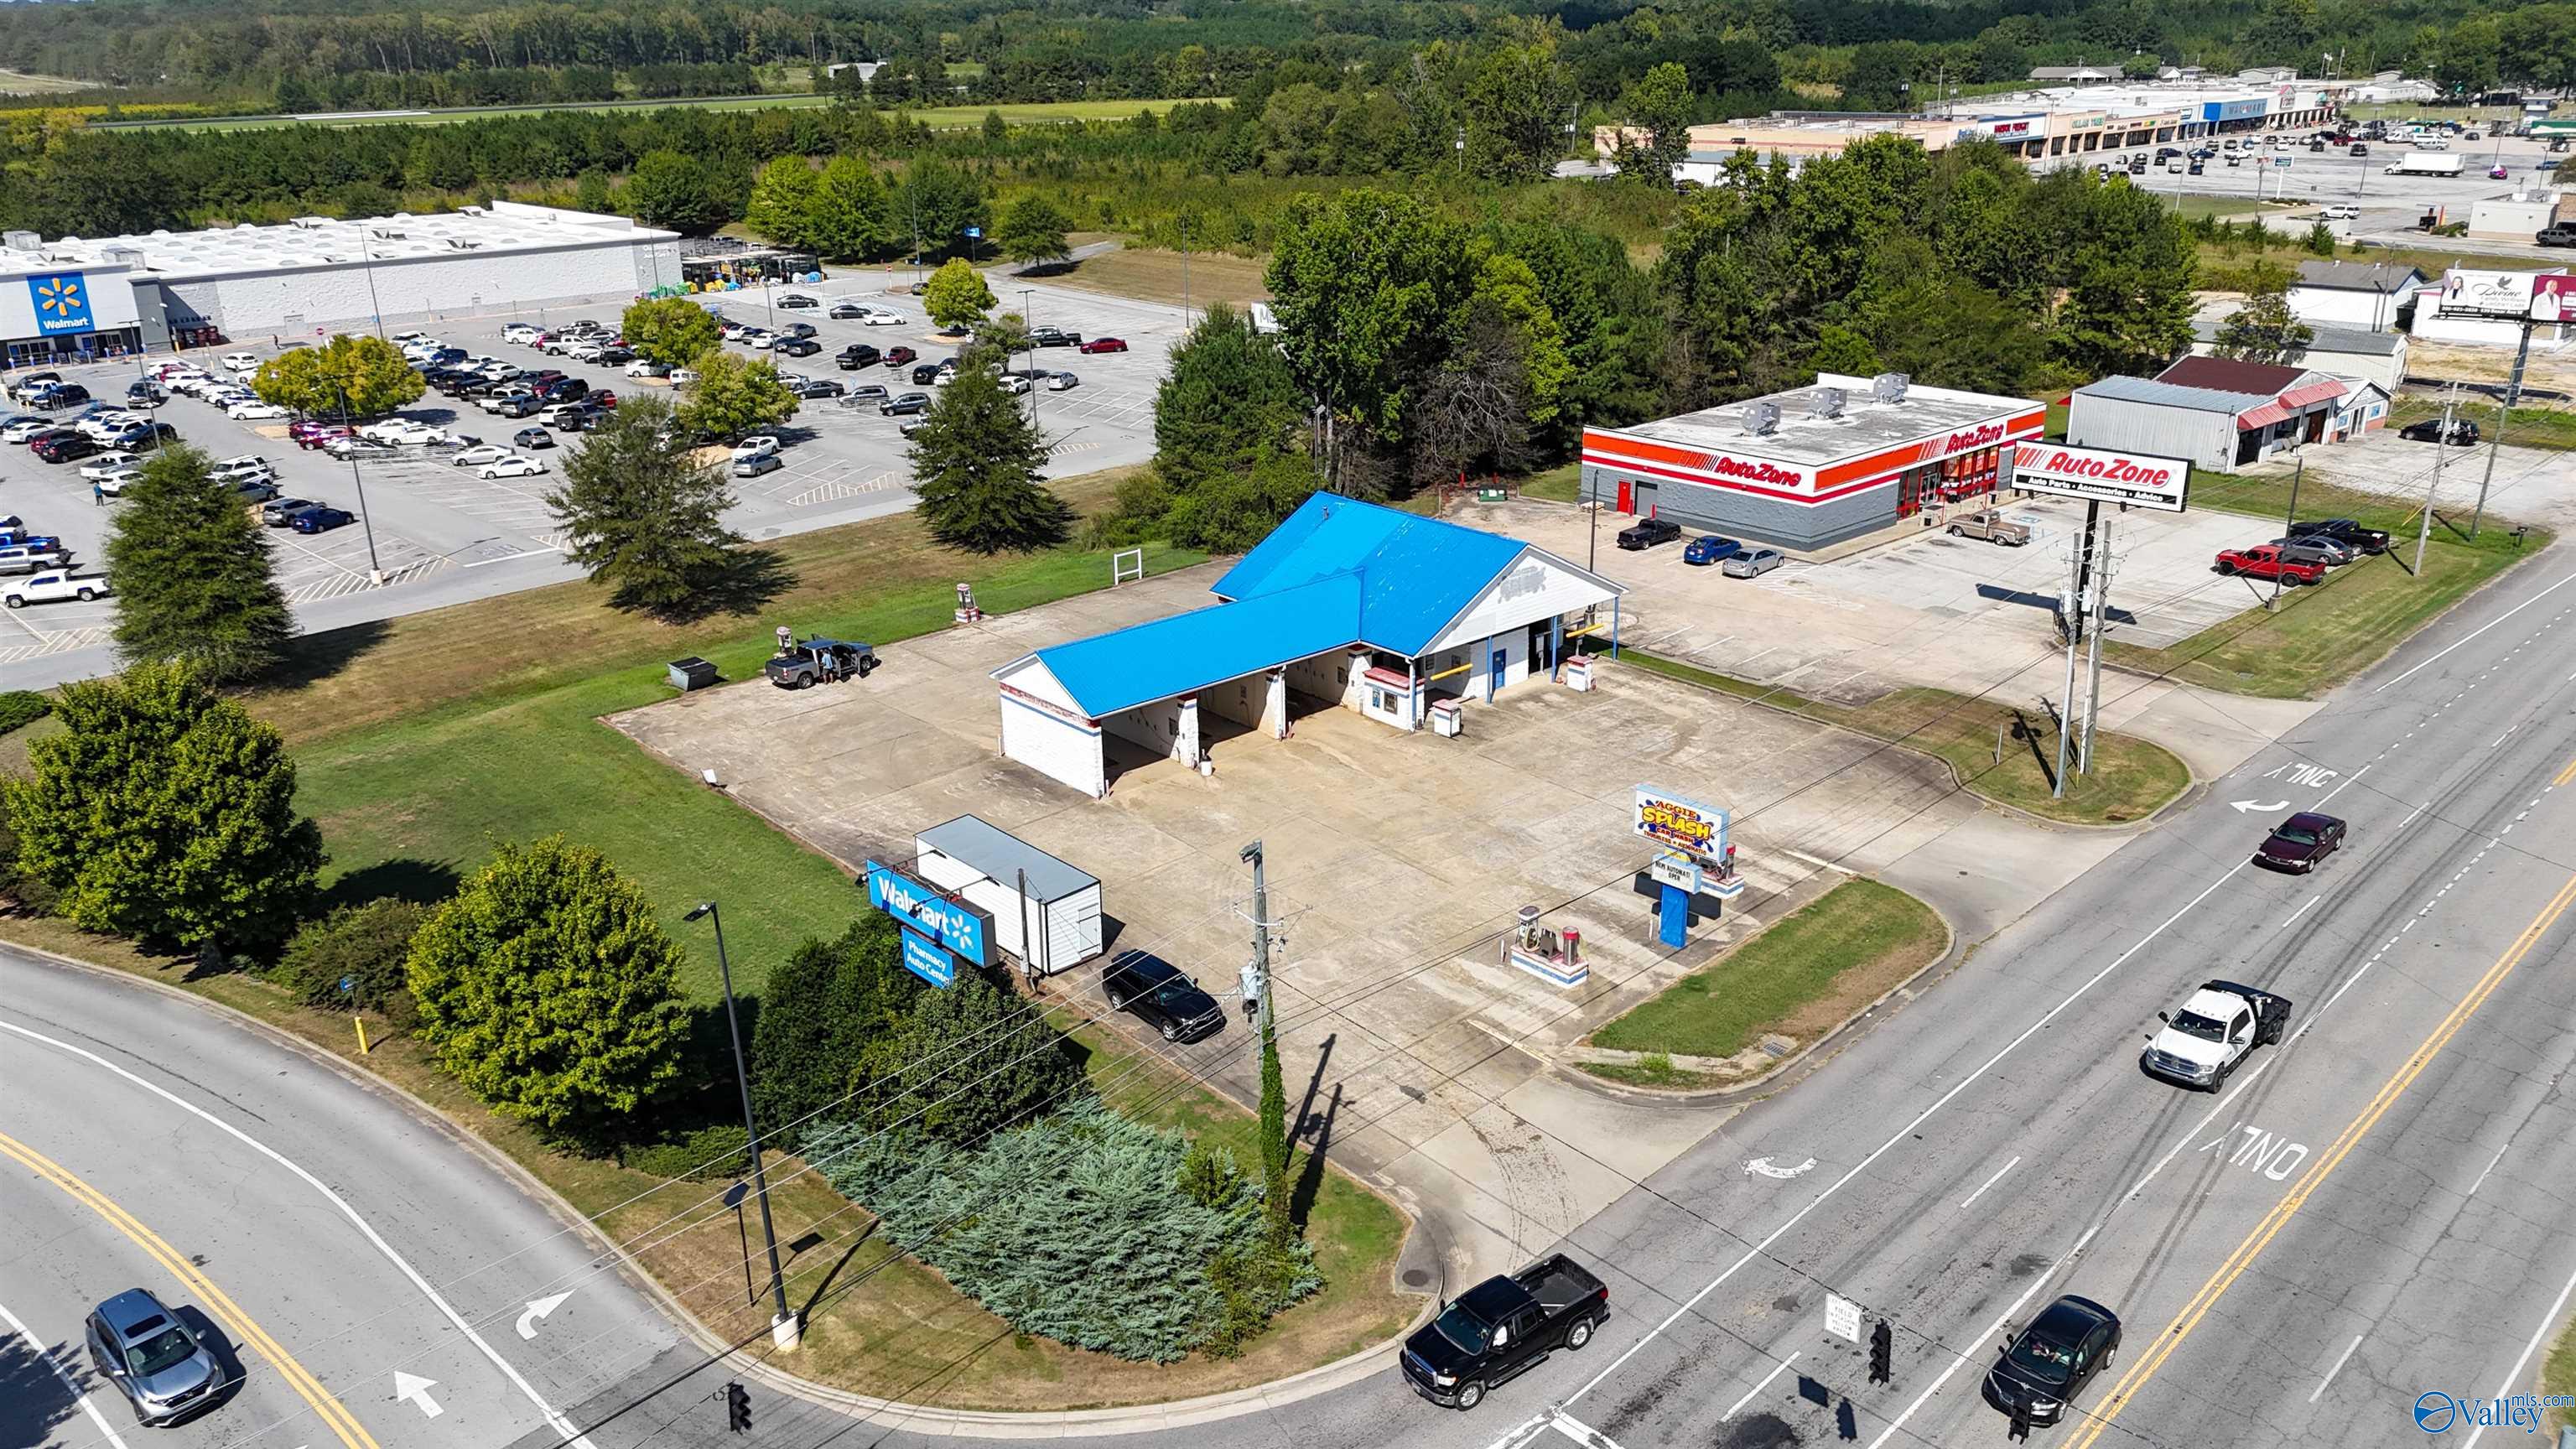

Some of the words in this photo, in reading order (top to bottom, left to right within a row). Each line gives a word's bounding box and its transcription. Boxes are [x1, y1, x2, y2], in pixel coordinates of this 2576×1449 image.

[2471, 283, 2522, 297] Divine
[43, 317, 90, 330] Walmart
[1945, 423, 2004, 454] AutoZone
[1714, 457, 1802, 487] AutoZone
[2044, 451, 2171, 489] AutoZone
[2028, 476, 2047, 486] Auto
[2049, 480, 2070, 490] Parts
[2077, 483, 2127, 498] Accessories
[2134, 491, 2163, 502] Advice
[1642, 806, 1711, 841] SPLASH
[906, 952, 925, 970] Auto
[908, 940, 946, 972] Pharmacy
[2199, 1121, 2309, 1181] ONLY
